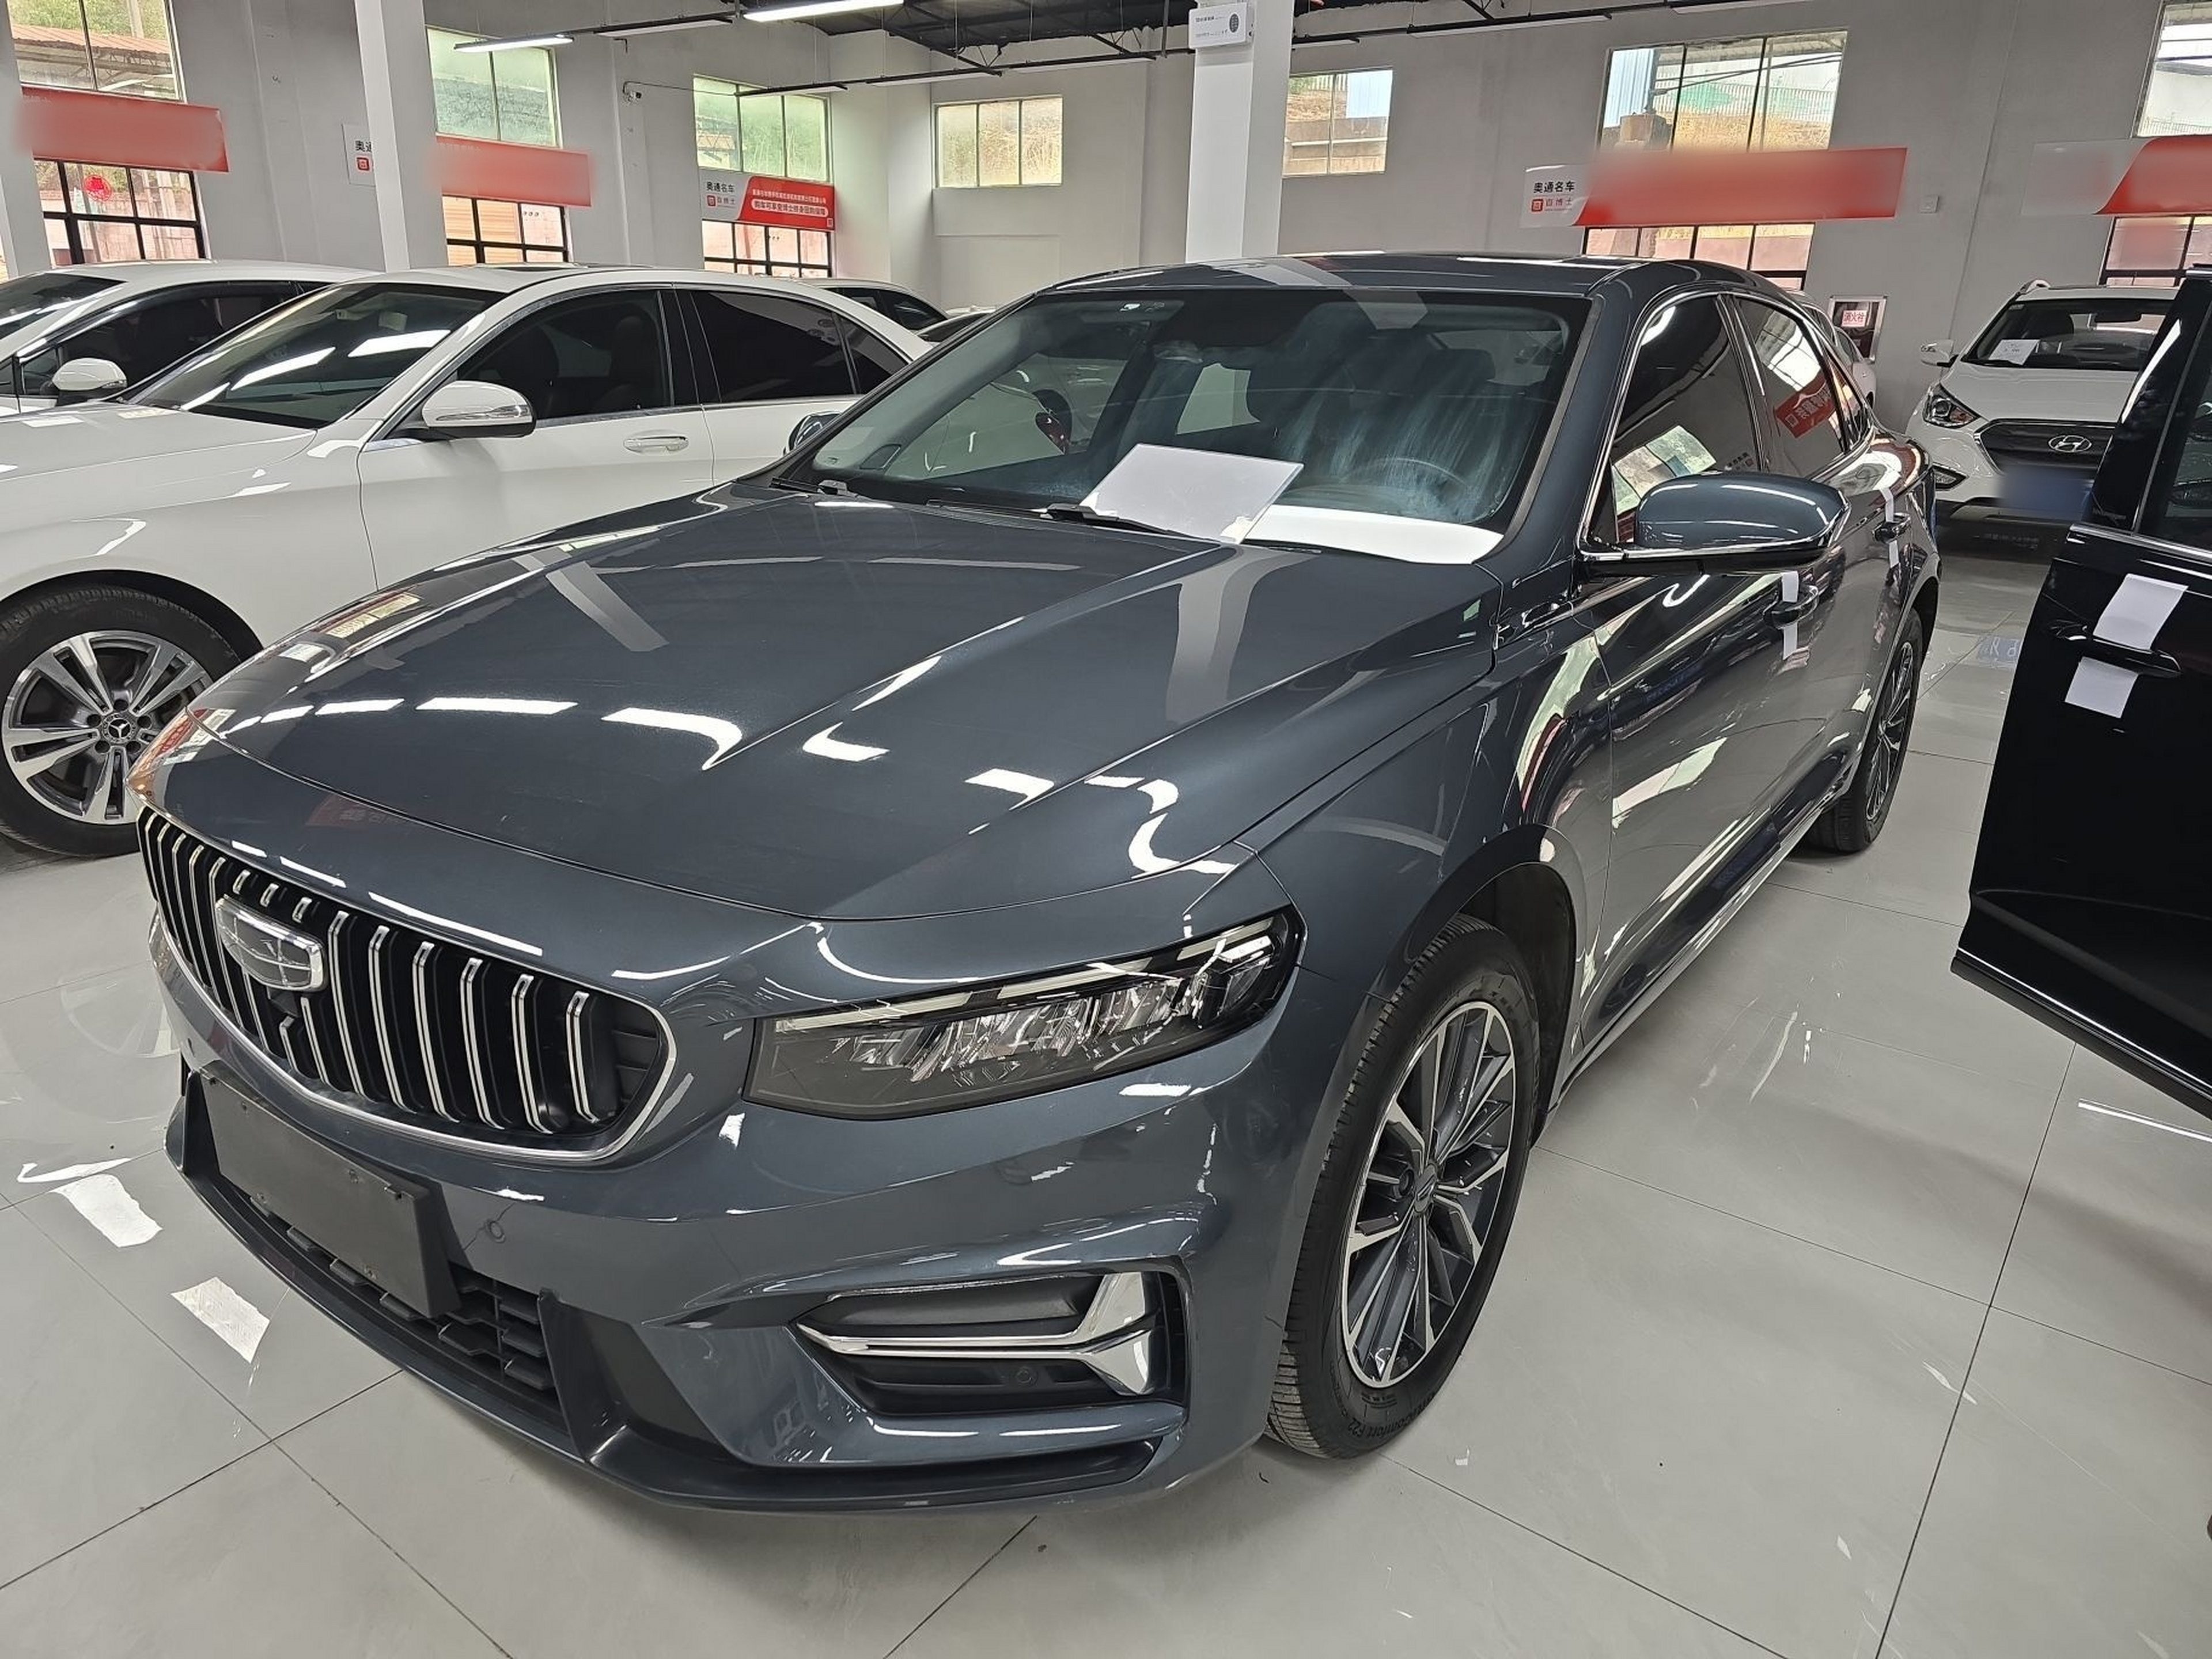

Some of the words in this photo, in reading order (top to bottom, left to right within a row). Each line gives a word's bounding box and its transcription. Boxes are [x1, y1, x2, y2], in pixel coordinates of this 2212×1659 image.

[706, 181, 735, 192] 奥通名车
[1533, 181, 1575, 193] 奥通名车
[1843, 312, 1865, 322] 消火栓
